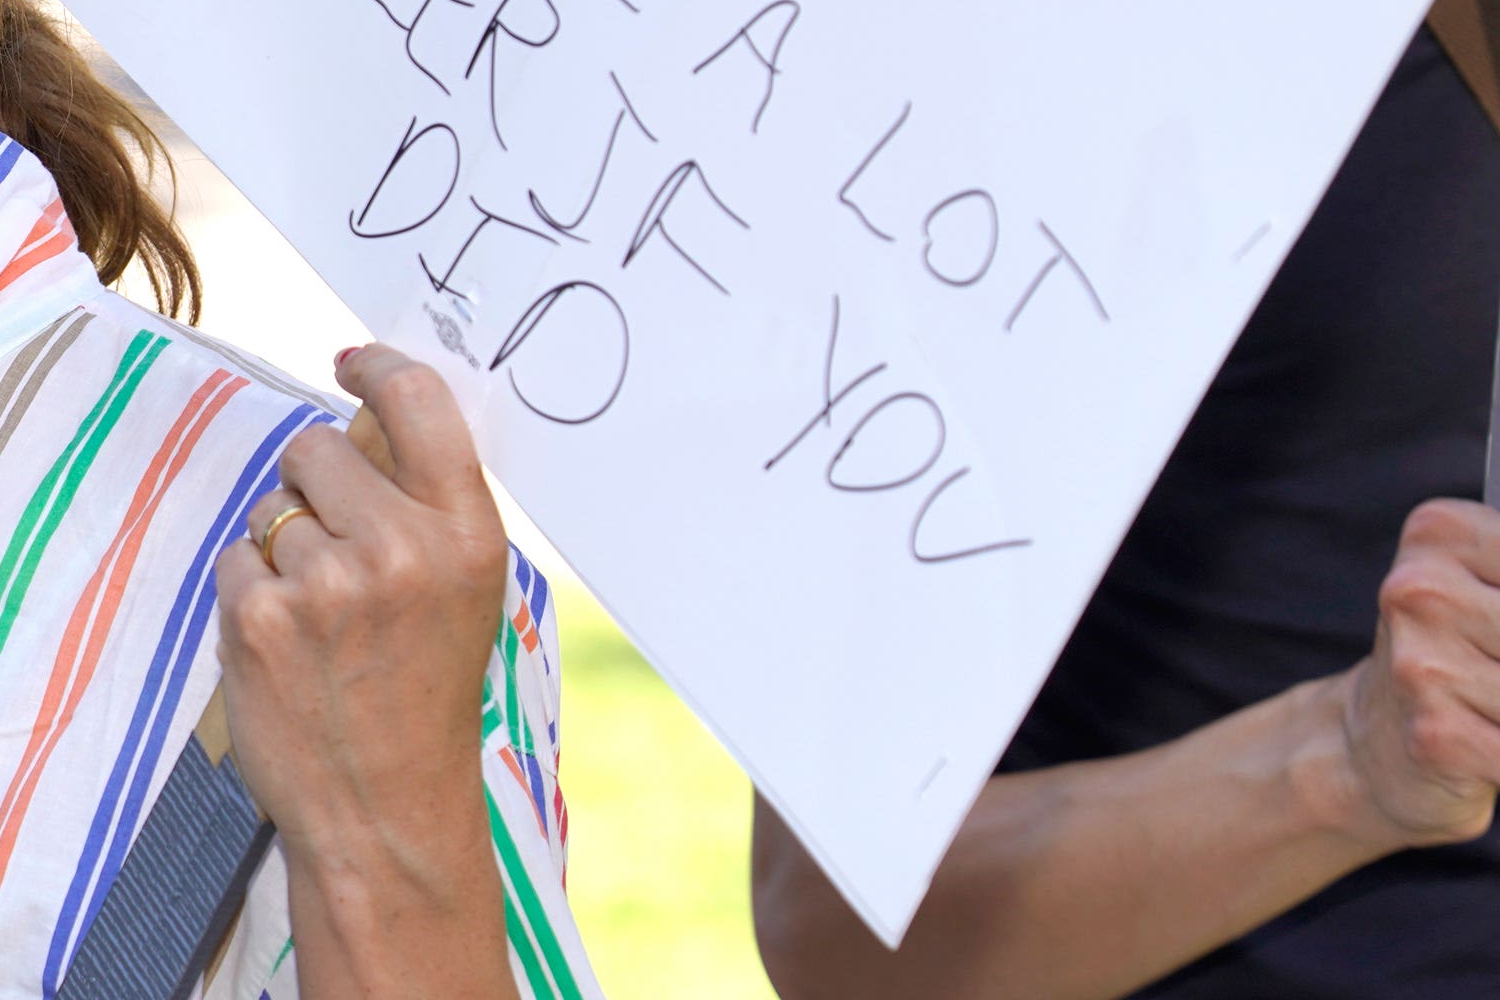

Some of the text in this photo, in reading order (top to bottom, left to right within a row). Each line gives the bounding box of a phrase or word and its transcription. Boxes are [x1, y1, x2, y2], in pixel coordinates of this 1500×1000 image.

[348, 115, 631, 425] DID
[528, 70, 751, 297] IF
[764, 293, 1034, 563] YOU
[837, 100, 1110, 332] LOT
